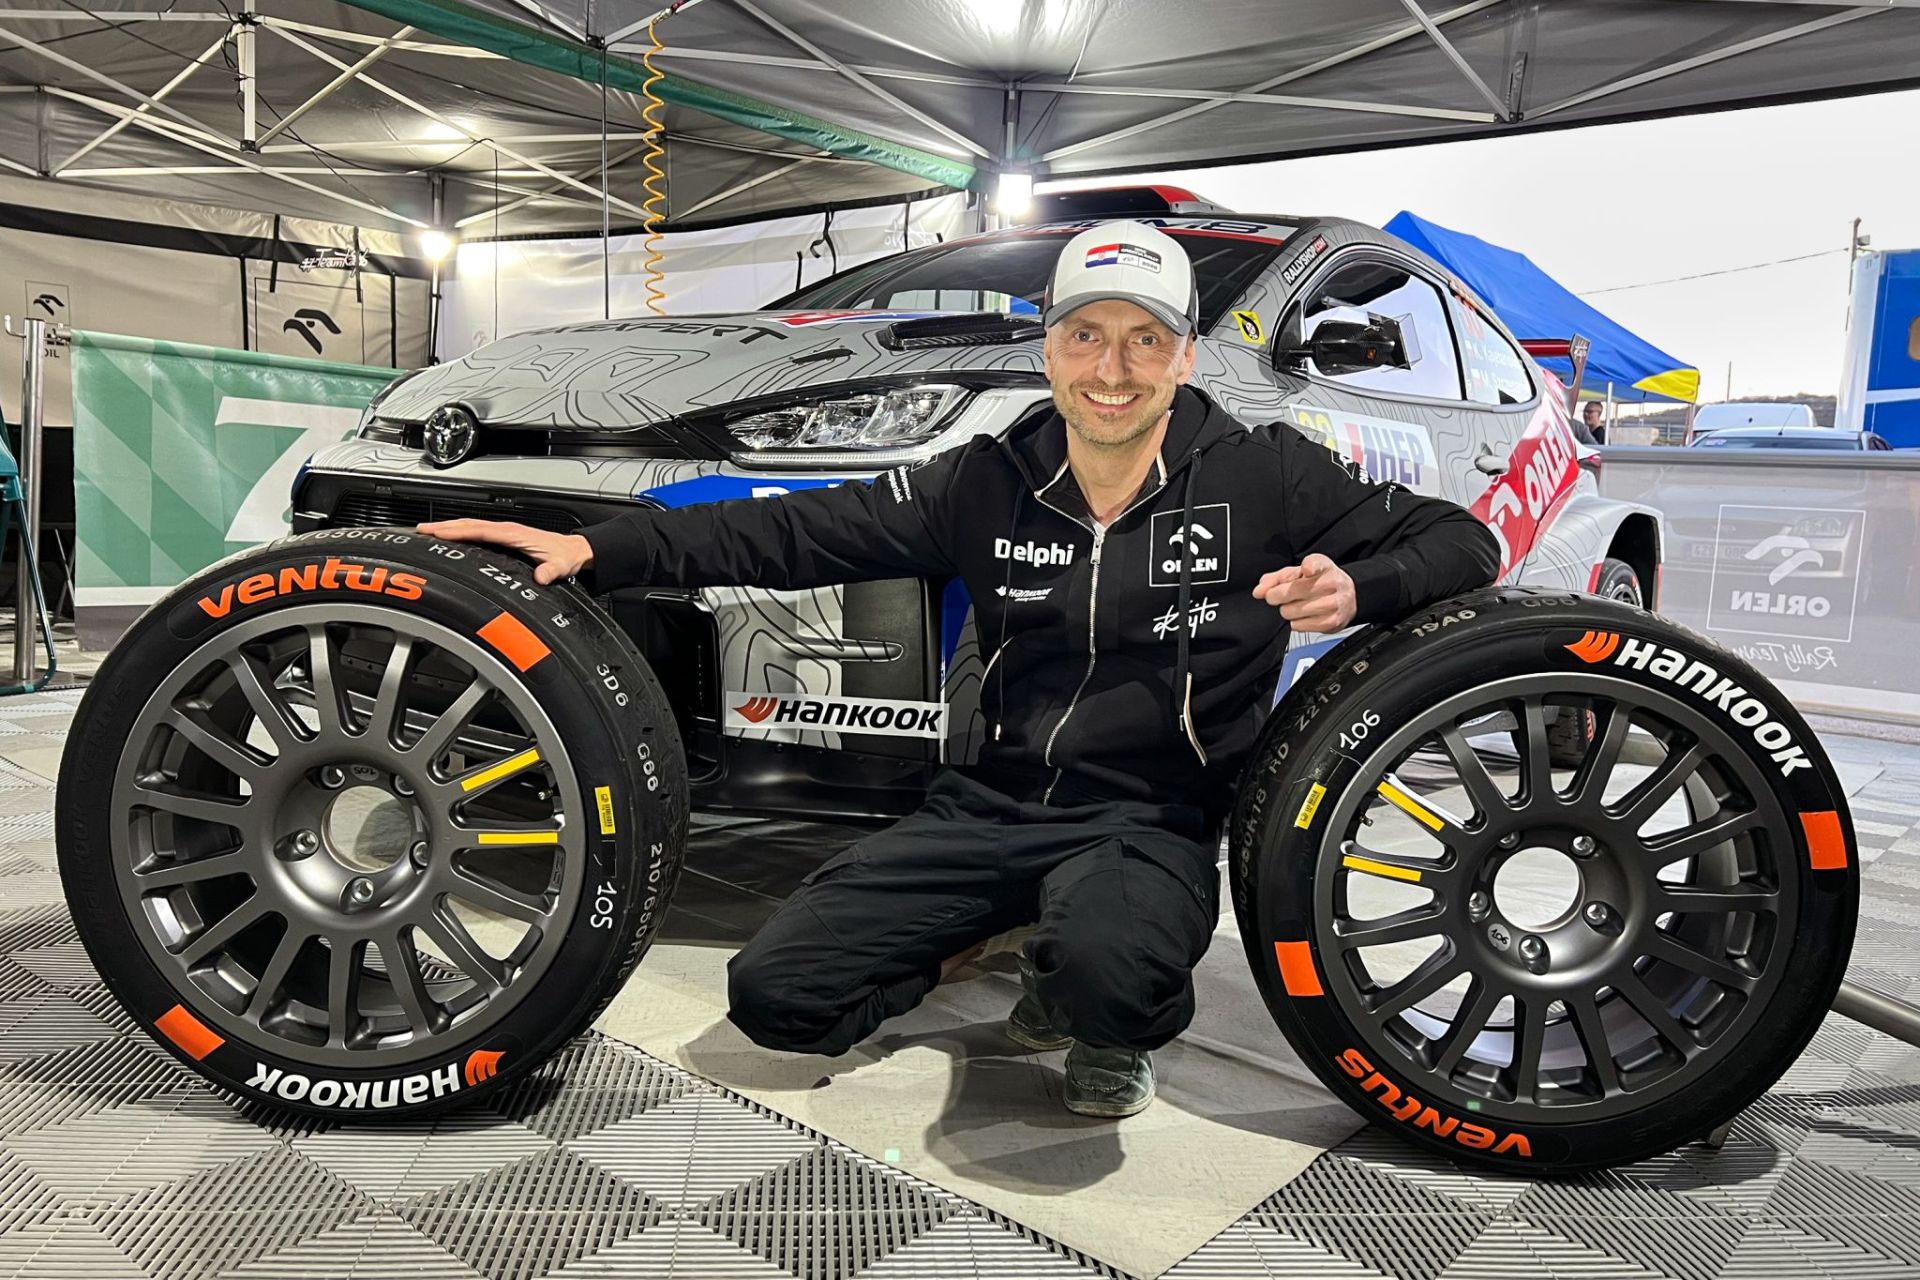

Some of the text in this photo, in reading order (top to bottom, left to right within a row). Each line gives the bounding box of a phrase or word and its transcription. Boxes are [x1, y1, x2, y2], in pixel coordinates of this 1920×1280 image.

[994, 537, 1075, 568] Delphi
[1162, 557, 1218, 573] OEN
[428, 543, 465, 560] RD
[478, 562, 539, 601] Z215
[596, 663, 629, 707] 3D6
[637, 742, 659, 792] G66
[1268, 741, 1290, 775] RD
[1296, 682, 1342, 732] Z215
[1338, 708, 1381, 751] 106
[590, 881, 618, 930] 105
